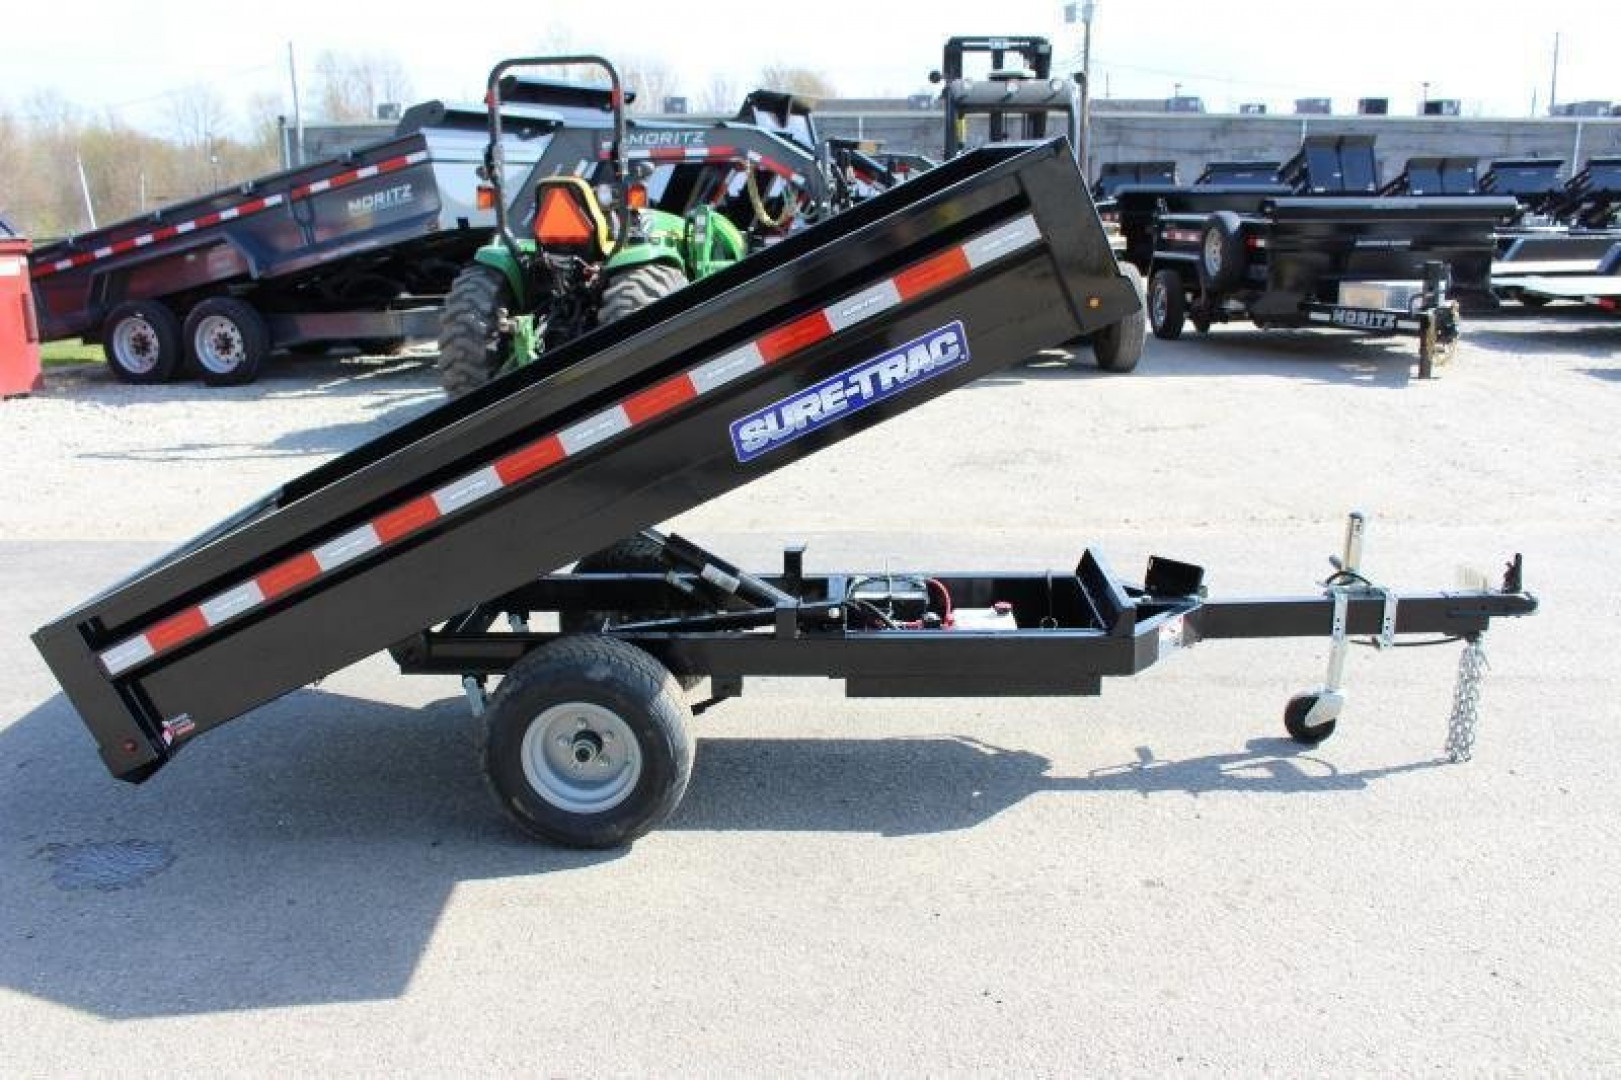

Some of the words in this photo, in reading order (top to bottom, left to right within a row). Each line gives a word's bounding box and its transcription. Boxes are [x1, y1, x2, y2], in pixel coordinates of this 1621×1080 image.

[630, 131, 704, 145] MORITZ
[347, 184, 412, 212] MORITZ
[1333, 309, 1397, 328] MORITZ
